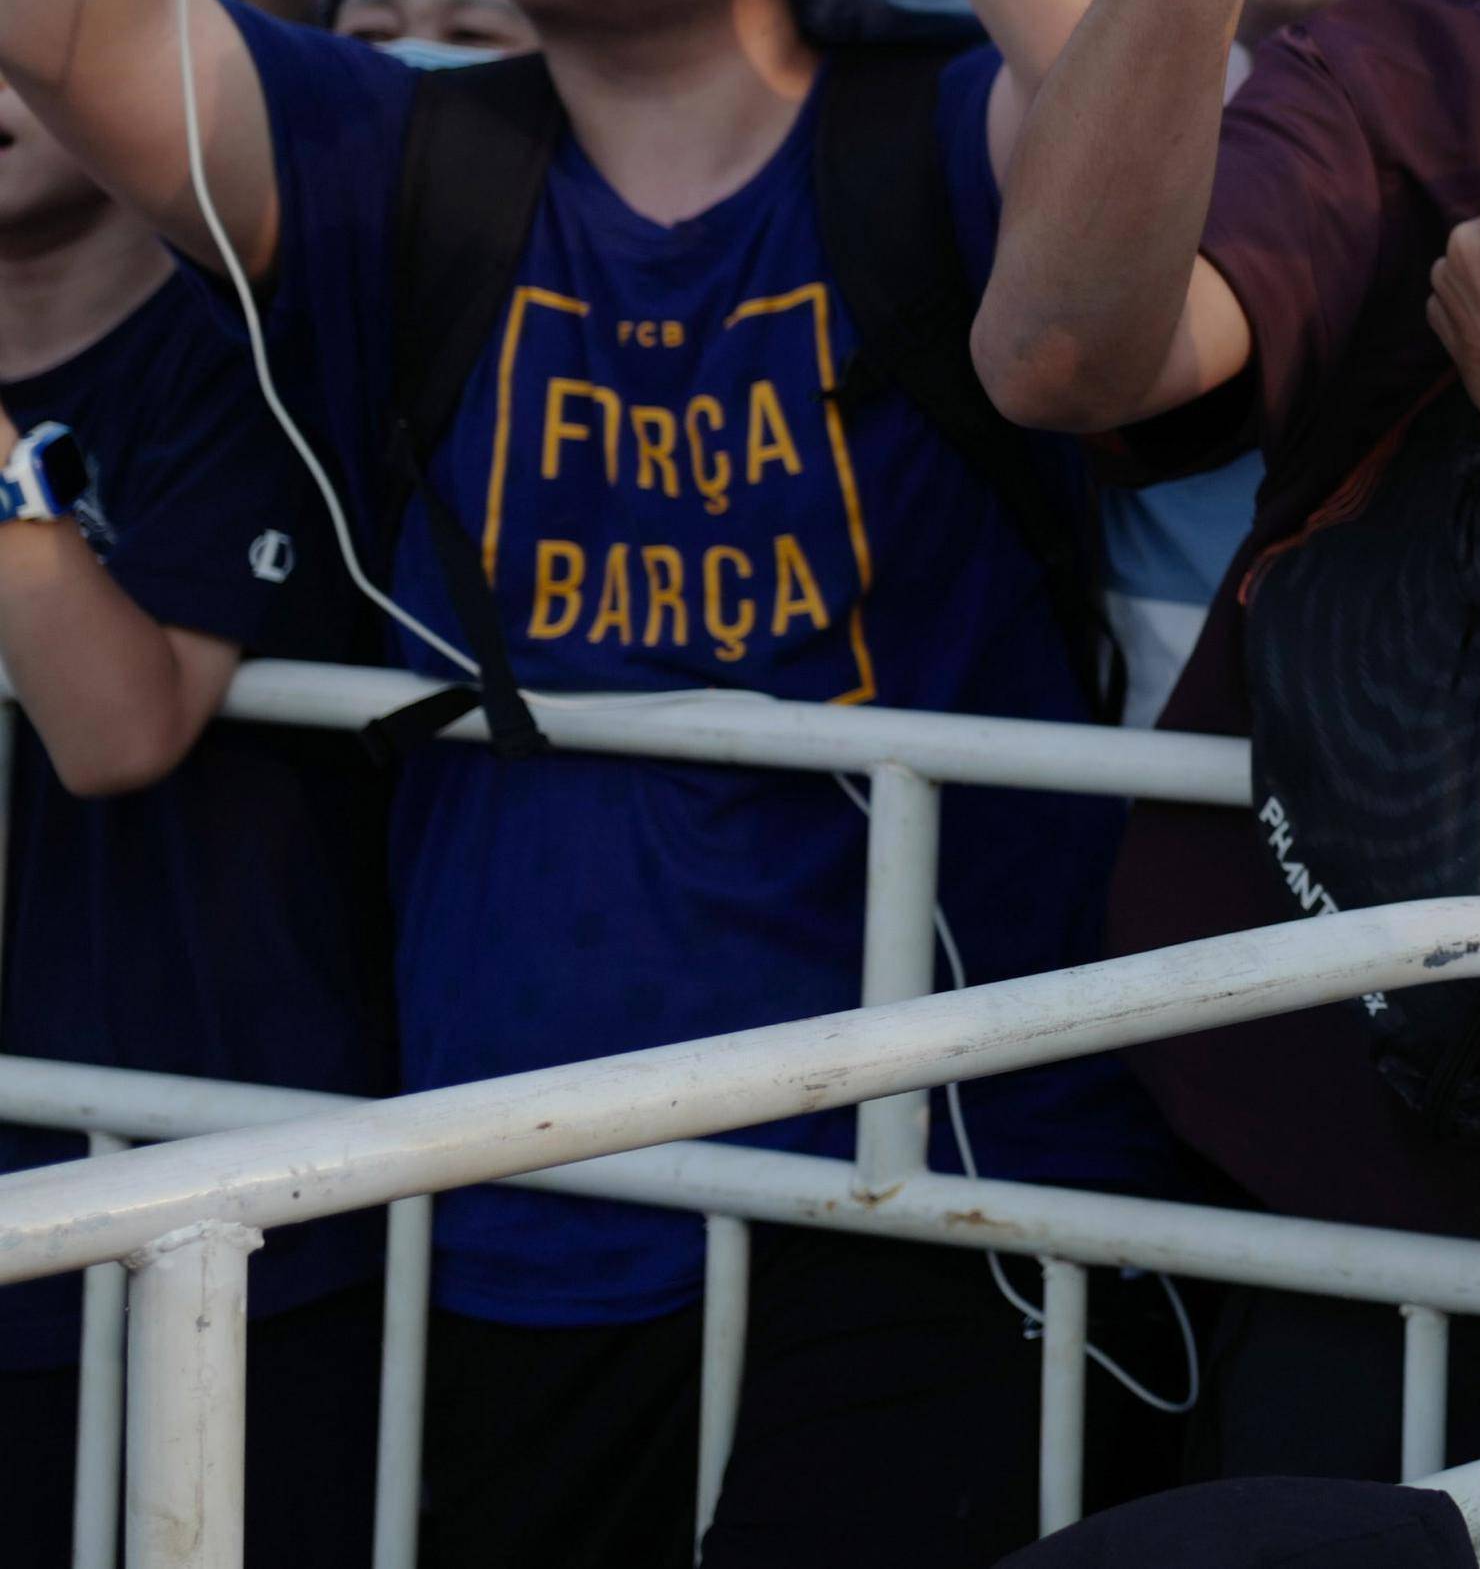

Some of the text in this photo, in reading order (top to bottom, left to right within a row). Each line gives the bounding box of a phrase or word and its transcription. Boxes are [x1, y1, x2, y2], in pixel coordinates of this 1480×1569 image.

[618, 320, 685, 348] FCB
[527, 533, 830, 662] BARÇA
[1258, 795, 1339, 917] PHANT
